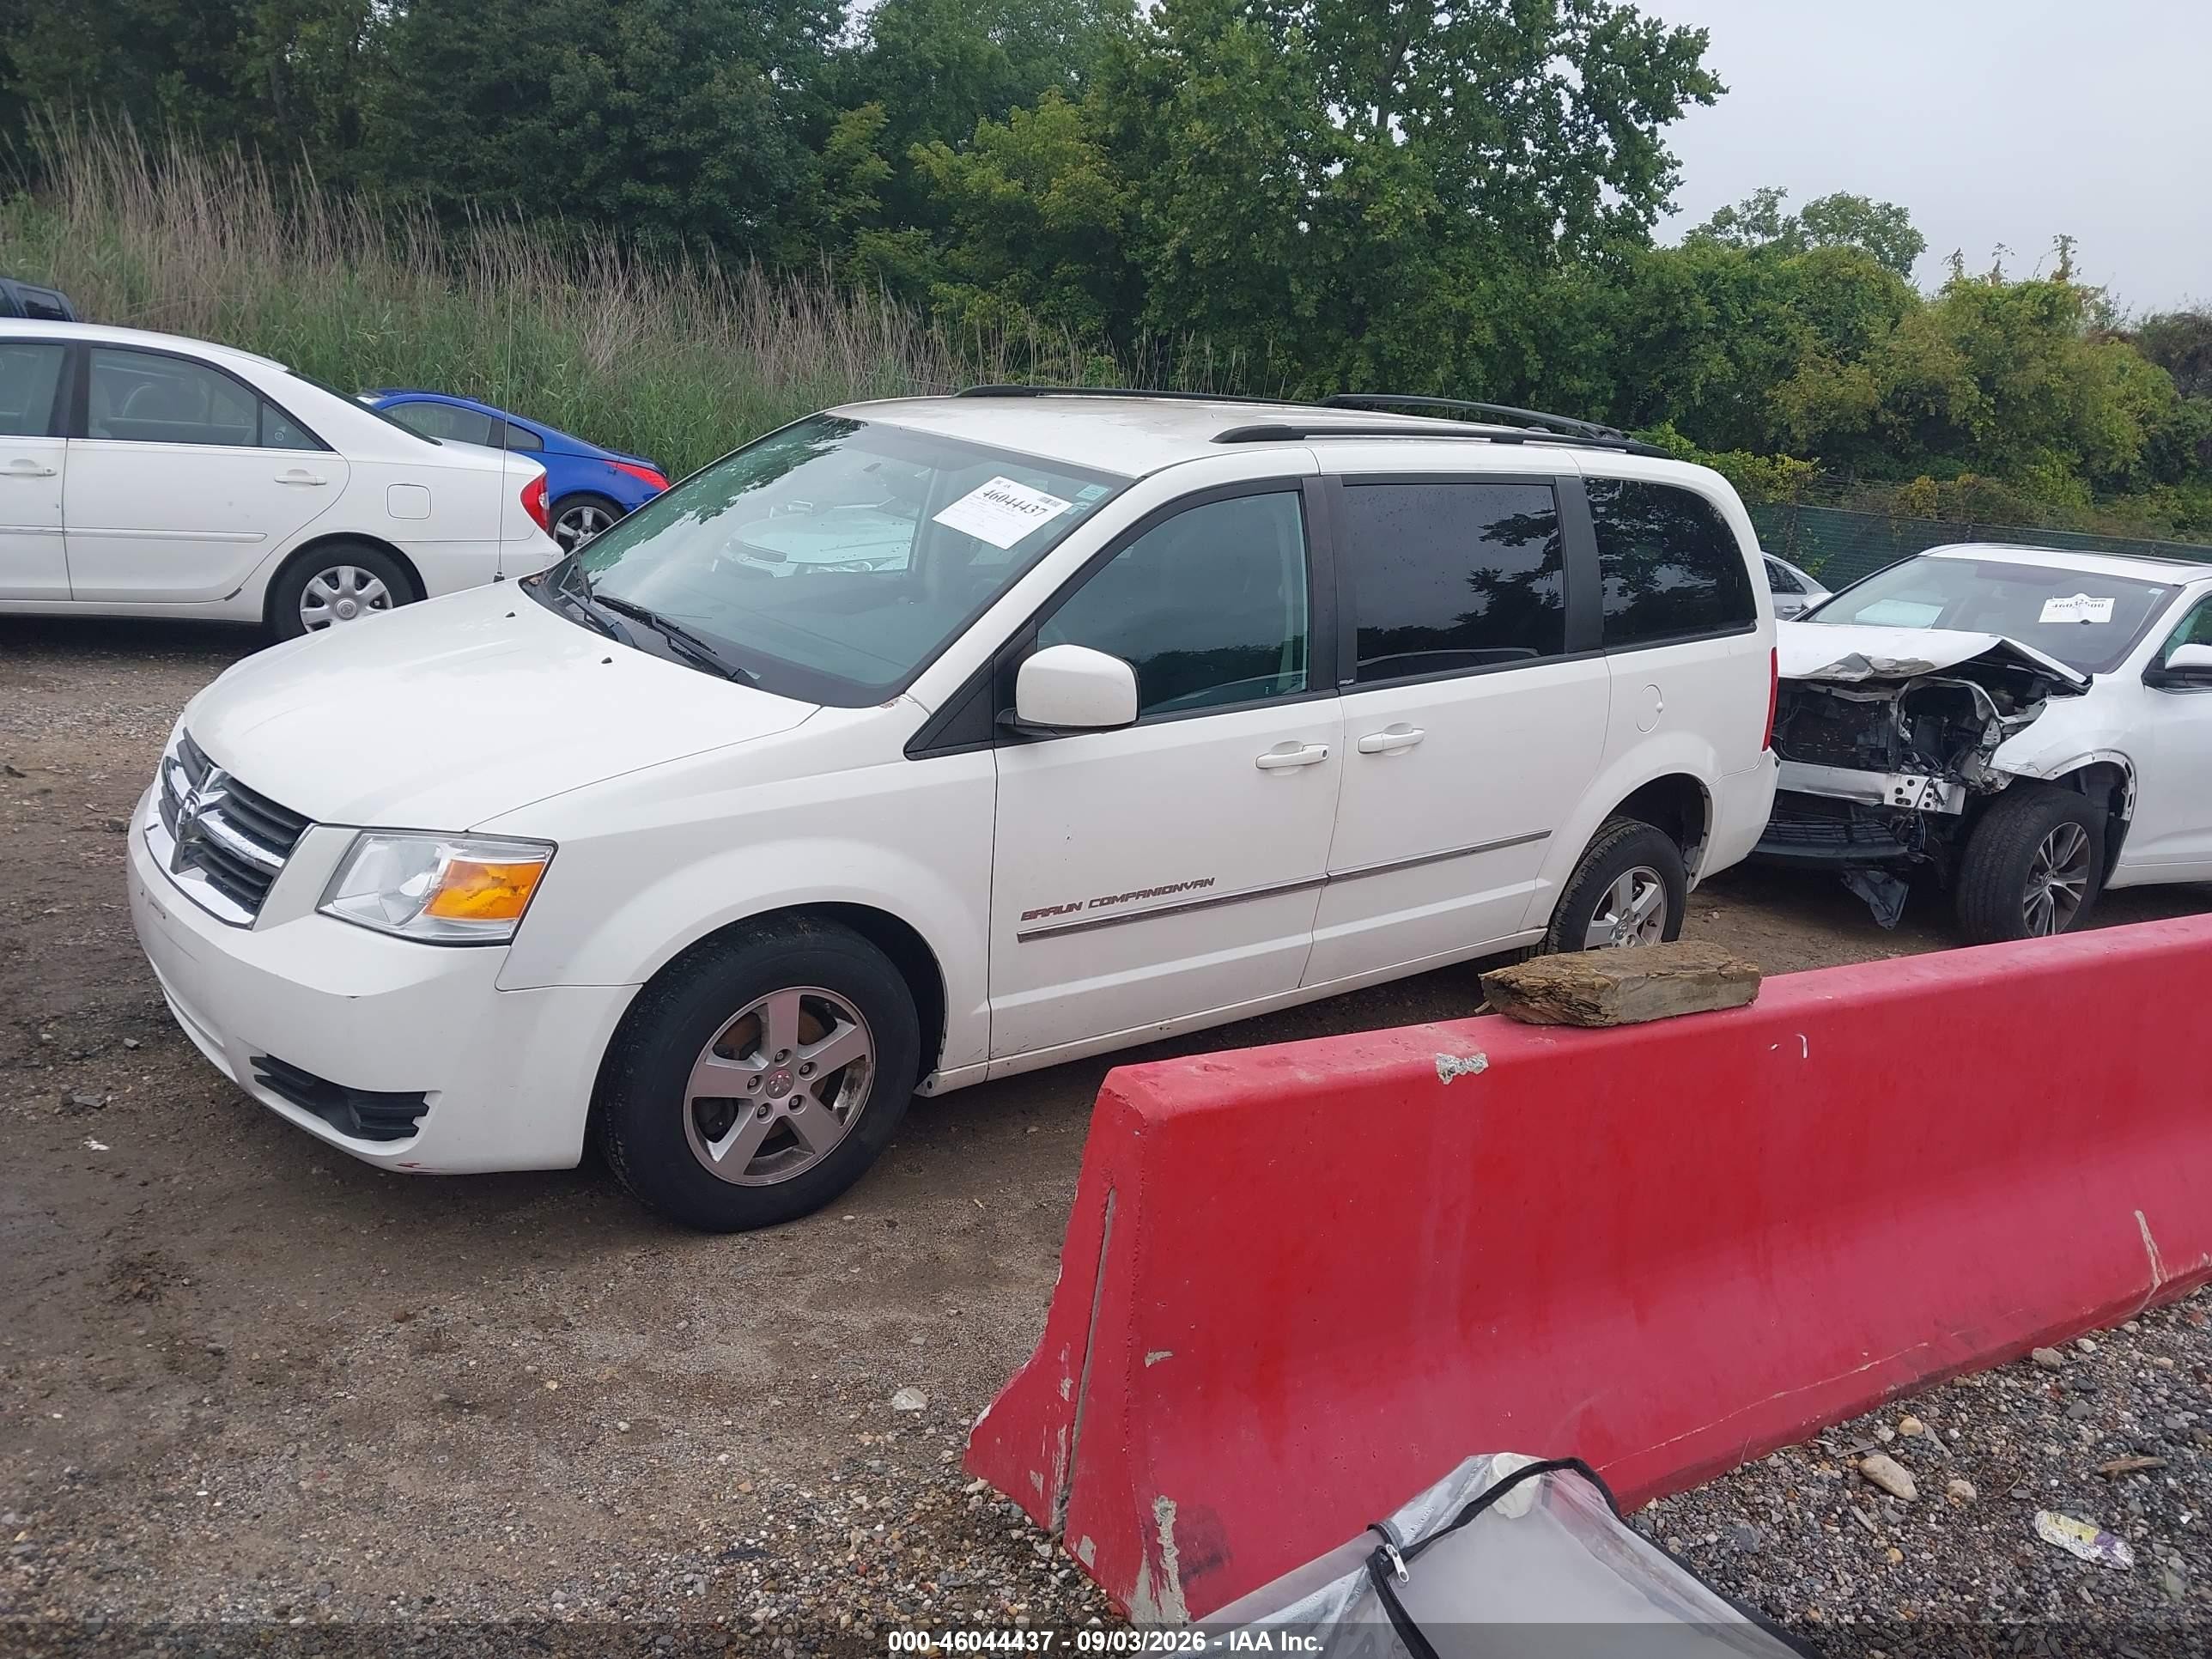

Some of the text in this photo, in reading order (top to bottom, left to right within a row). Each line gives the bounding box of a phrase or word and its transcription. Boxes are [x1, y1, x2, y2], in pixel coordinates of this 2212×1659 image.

[982, 489, 1048, 517] 46044437
[1020, 877, 1216, 921] BRAUN COMPANIONVAN
